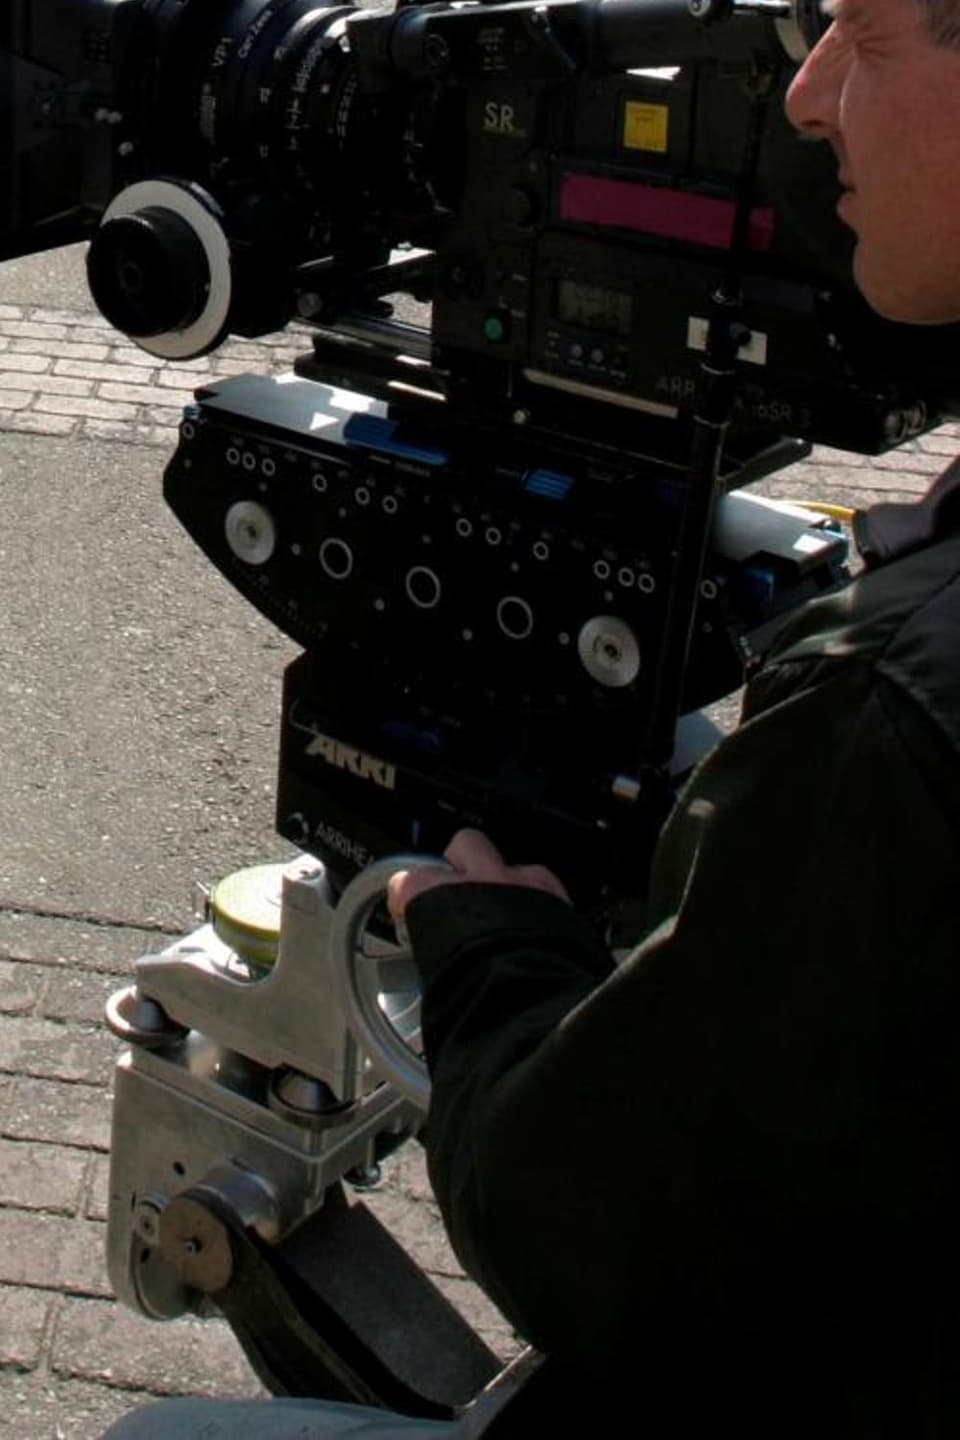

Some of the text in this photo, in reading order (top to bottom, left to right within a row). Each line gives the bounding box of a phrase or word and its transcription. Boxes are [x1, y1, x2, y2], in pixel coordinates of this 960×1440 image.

[483, 101, 515, 131] SR
[655, 375, 698, 400] ARR
[303, 734, 398, 791] ARRI
